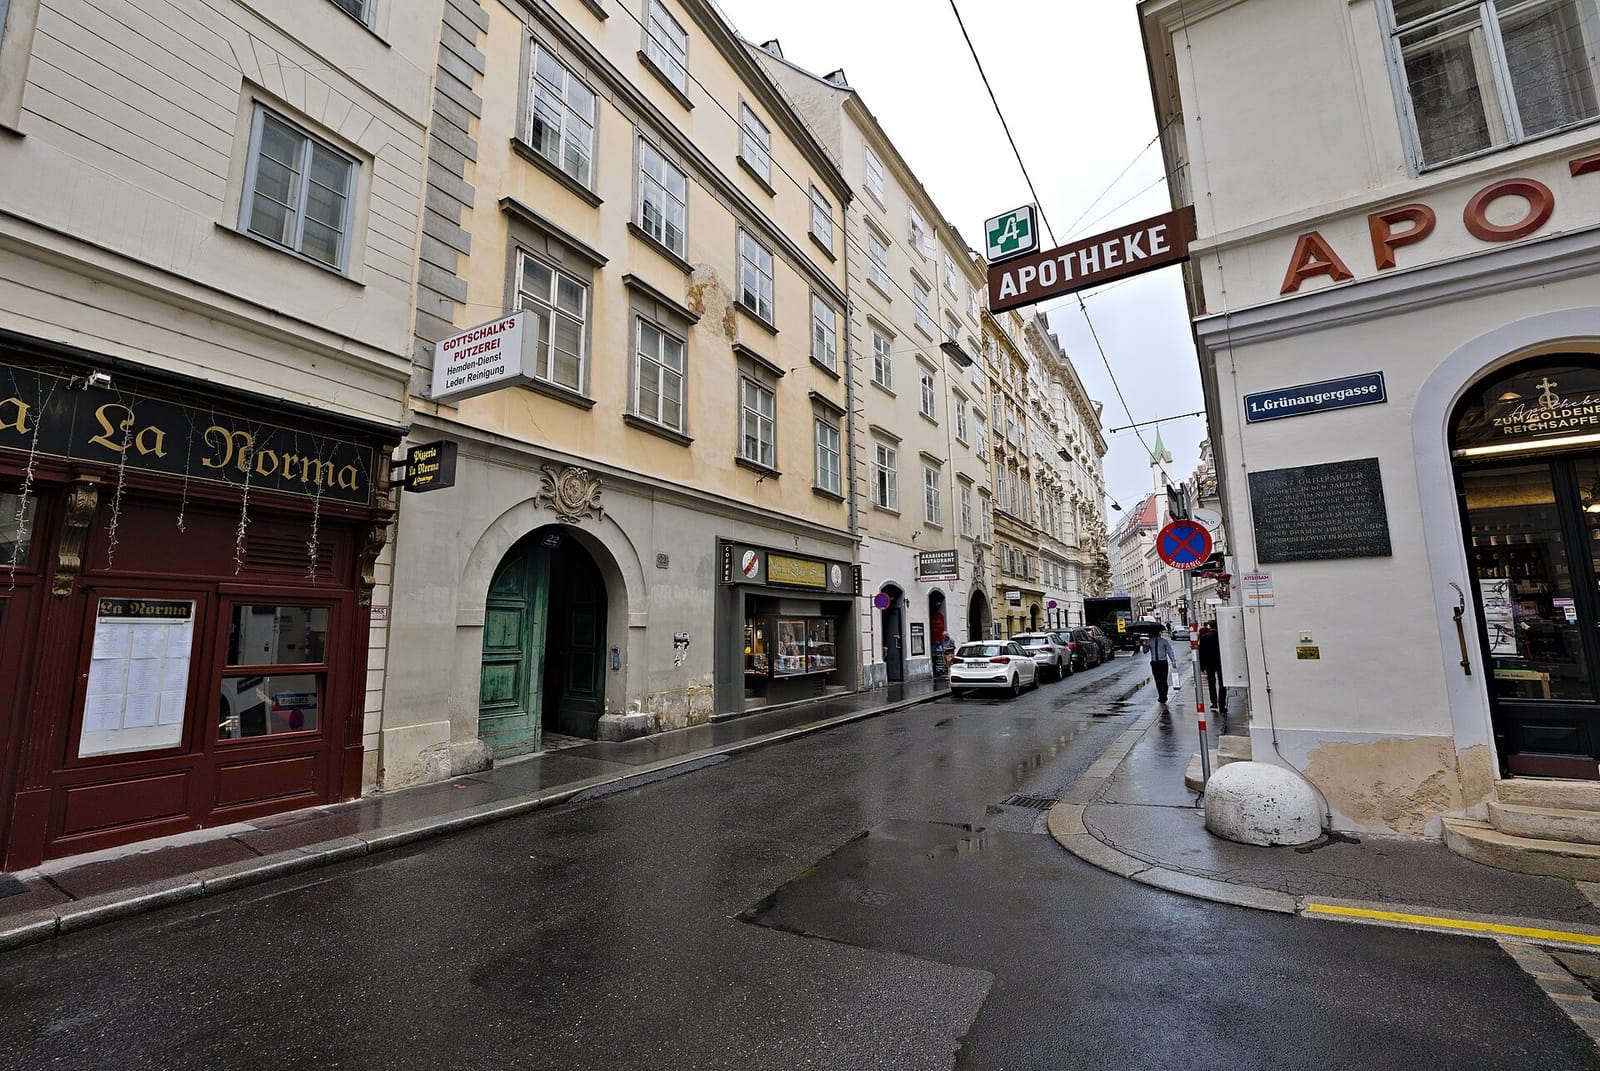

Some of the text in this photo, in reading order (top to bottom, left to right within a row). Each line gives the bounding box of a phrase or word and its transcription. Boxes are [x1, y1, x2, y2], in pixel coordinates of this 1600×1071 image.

[999, 224, 1170, 300] APOTHEKE
[443, 318, 516, 351] GOTTSCHALK'S
[454, 338, 500, 362] PUTZEREI
[446, 352, 502, 376] Hemden-Dienst
[446, 365, 504, 388] Leder Reinigung
[1494, 416, 1524, 426] ZUM
[88, 403, 168, 458] La
[202, 425, 358, 492] Norma
[414, 448, 436, 464] Pizzeria
[1170, 560, 1201, 569] ANFANG
[100, 601, 186, 616] La Norma
